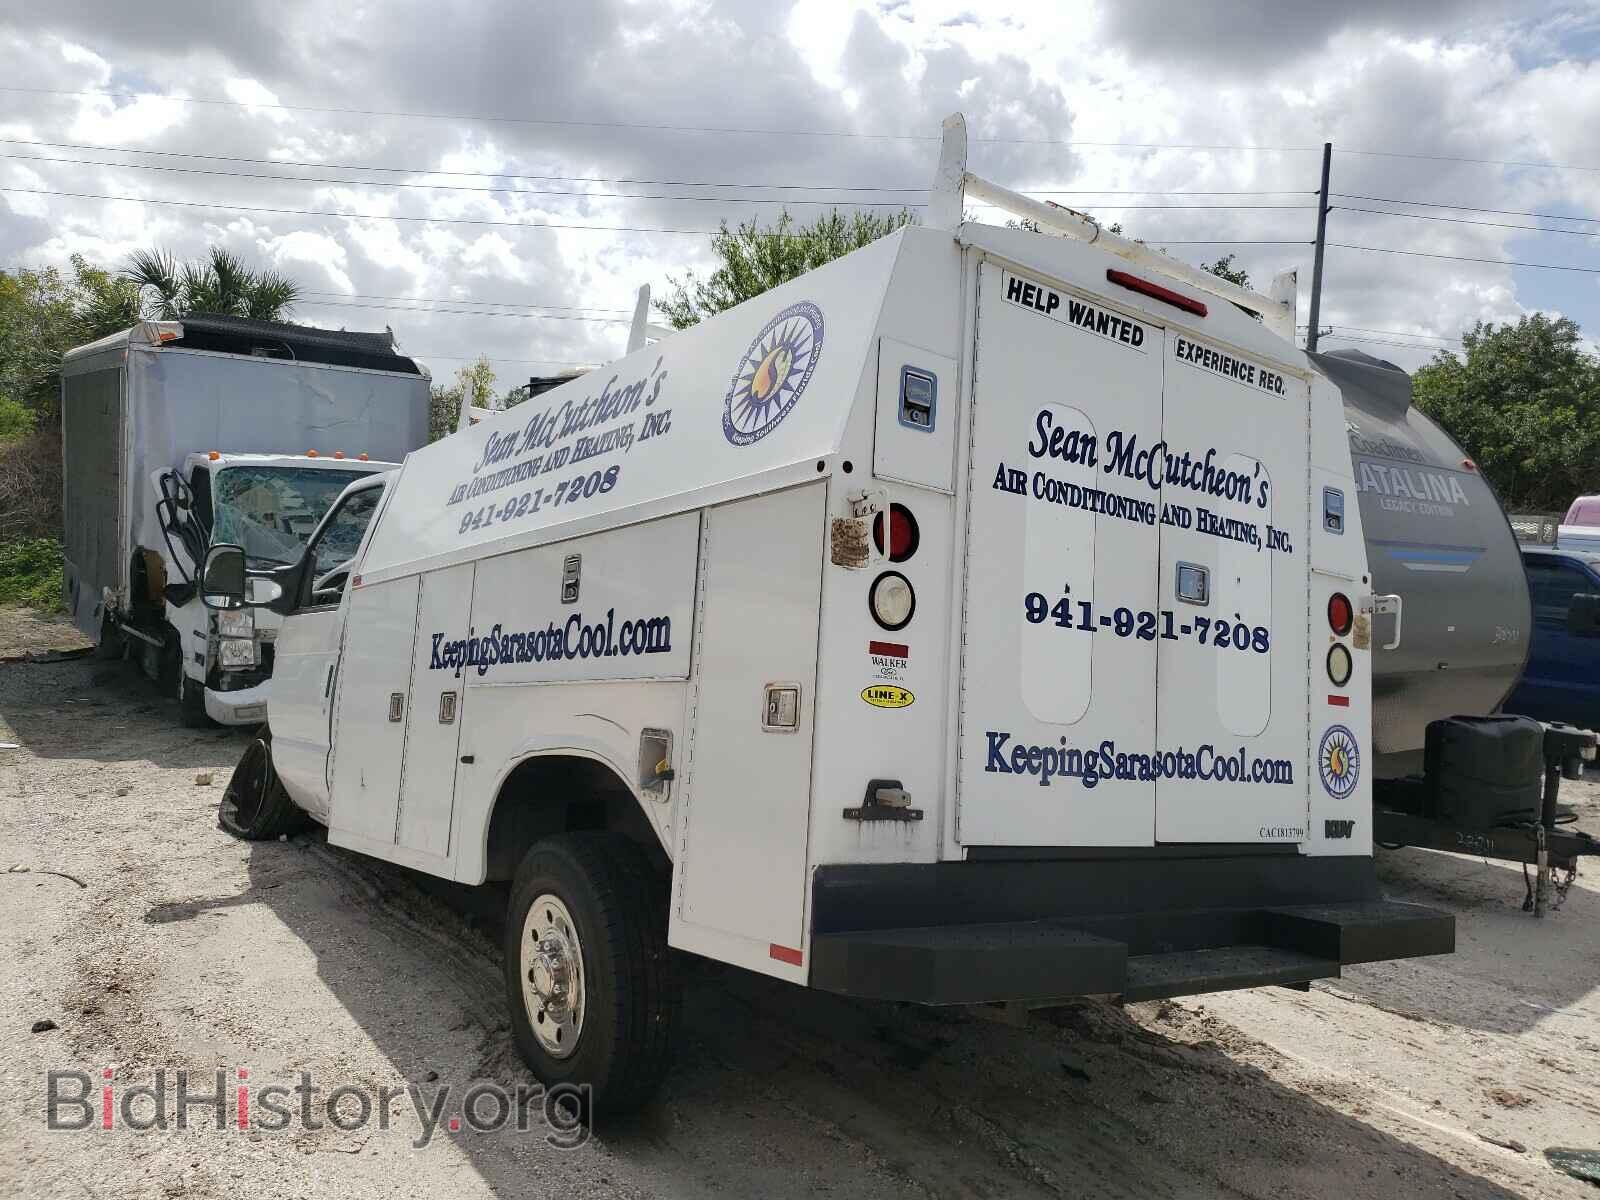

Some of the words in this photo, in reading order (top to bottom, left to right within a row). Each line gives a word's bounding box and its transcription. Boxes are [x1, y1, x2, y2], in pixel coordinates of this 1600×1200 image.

[1007, 277, 1060, 314] HELP
[1069, 300, 1144, 347] WANTED
[1176, 338, 1255, 384] EXPERIENCE
[1258, 369, 1287, 396] REQ.
[473, 431, 520, 474] Sean
[515, 354, 668, 457] McCutcheon's
[1028, 410, 1098, 467] Sean
[1104, 430, 1269, 509] McCutcheon's
[1354, 462, 1470, 506] ATALINA
[458, 464, 621, 535] 941-921-7208
[429, 607, 672, 677] KeepingSarasotaCool.com
[1024, 591, 1270, 654] 941-921-7208
[871, 656, 907, 669] WALKER
[985, 731, 1294, 789] KeepingSarasotaCool.com
